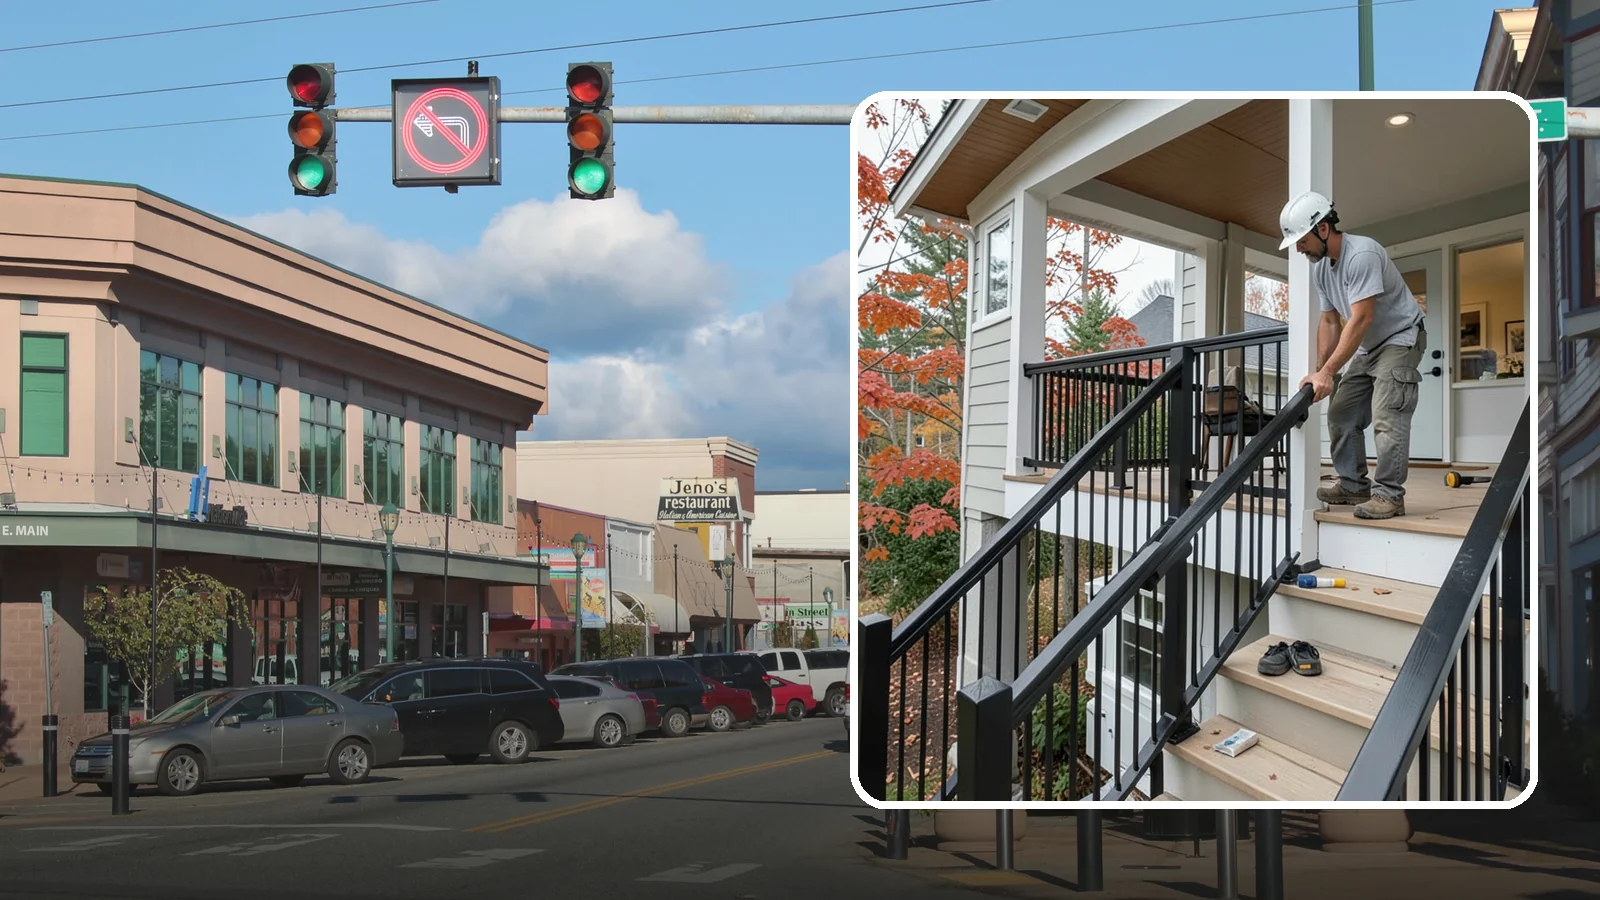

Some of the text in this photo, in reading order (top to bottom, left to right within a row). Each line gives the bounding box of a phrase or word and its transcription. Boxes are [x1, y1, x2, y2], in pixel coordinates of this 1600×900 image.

[669, 480, 728, 495] Jeno's
[665, 496, 731, 509] restaurant
[658, 510, 681, 519] Italian
[686, 510, 714, 519] American
[715, 510, 738, 519] Cuisine
[2, 525, 49, 536] E. MAIN
[797, 607, 829, 617] Street
